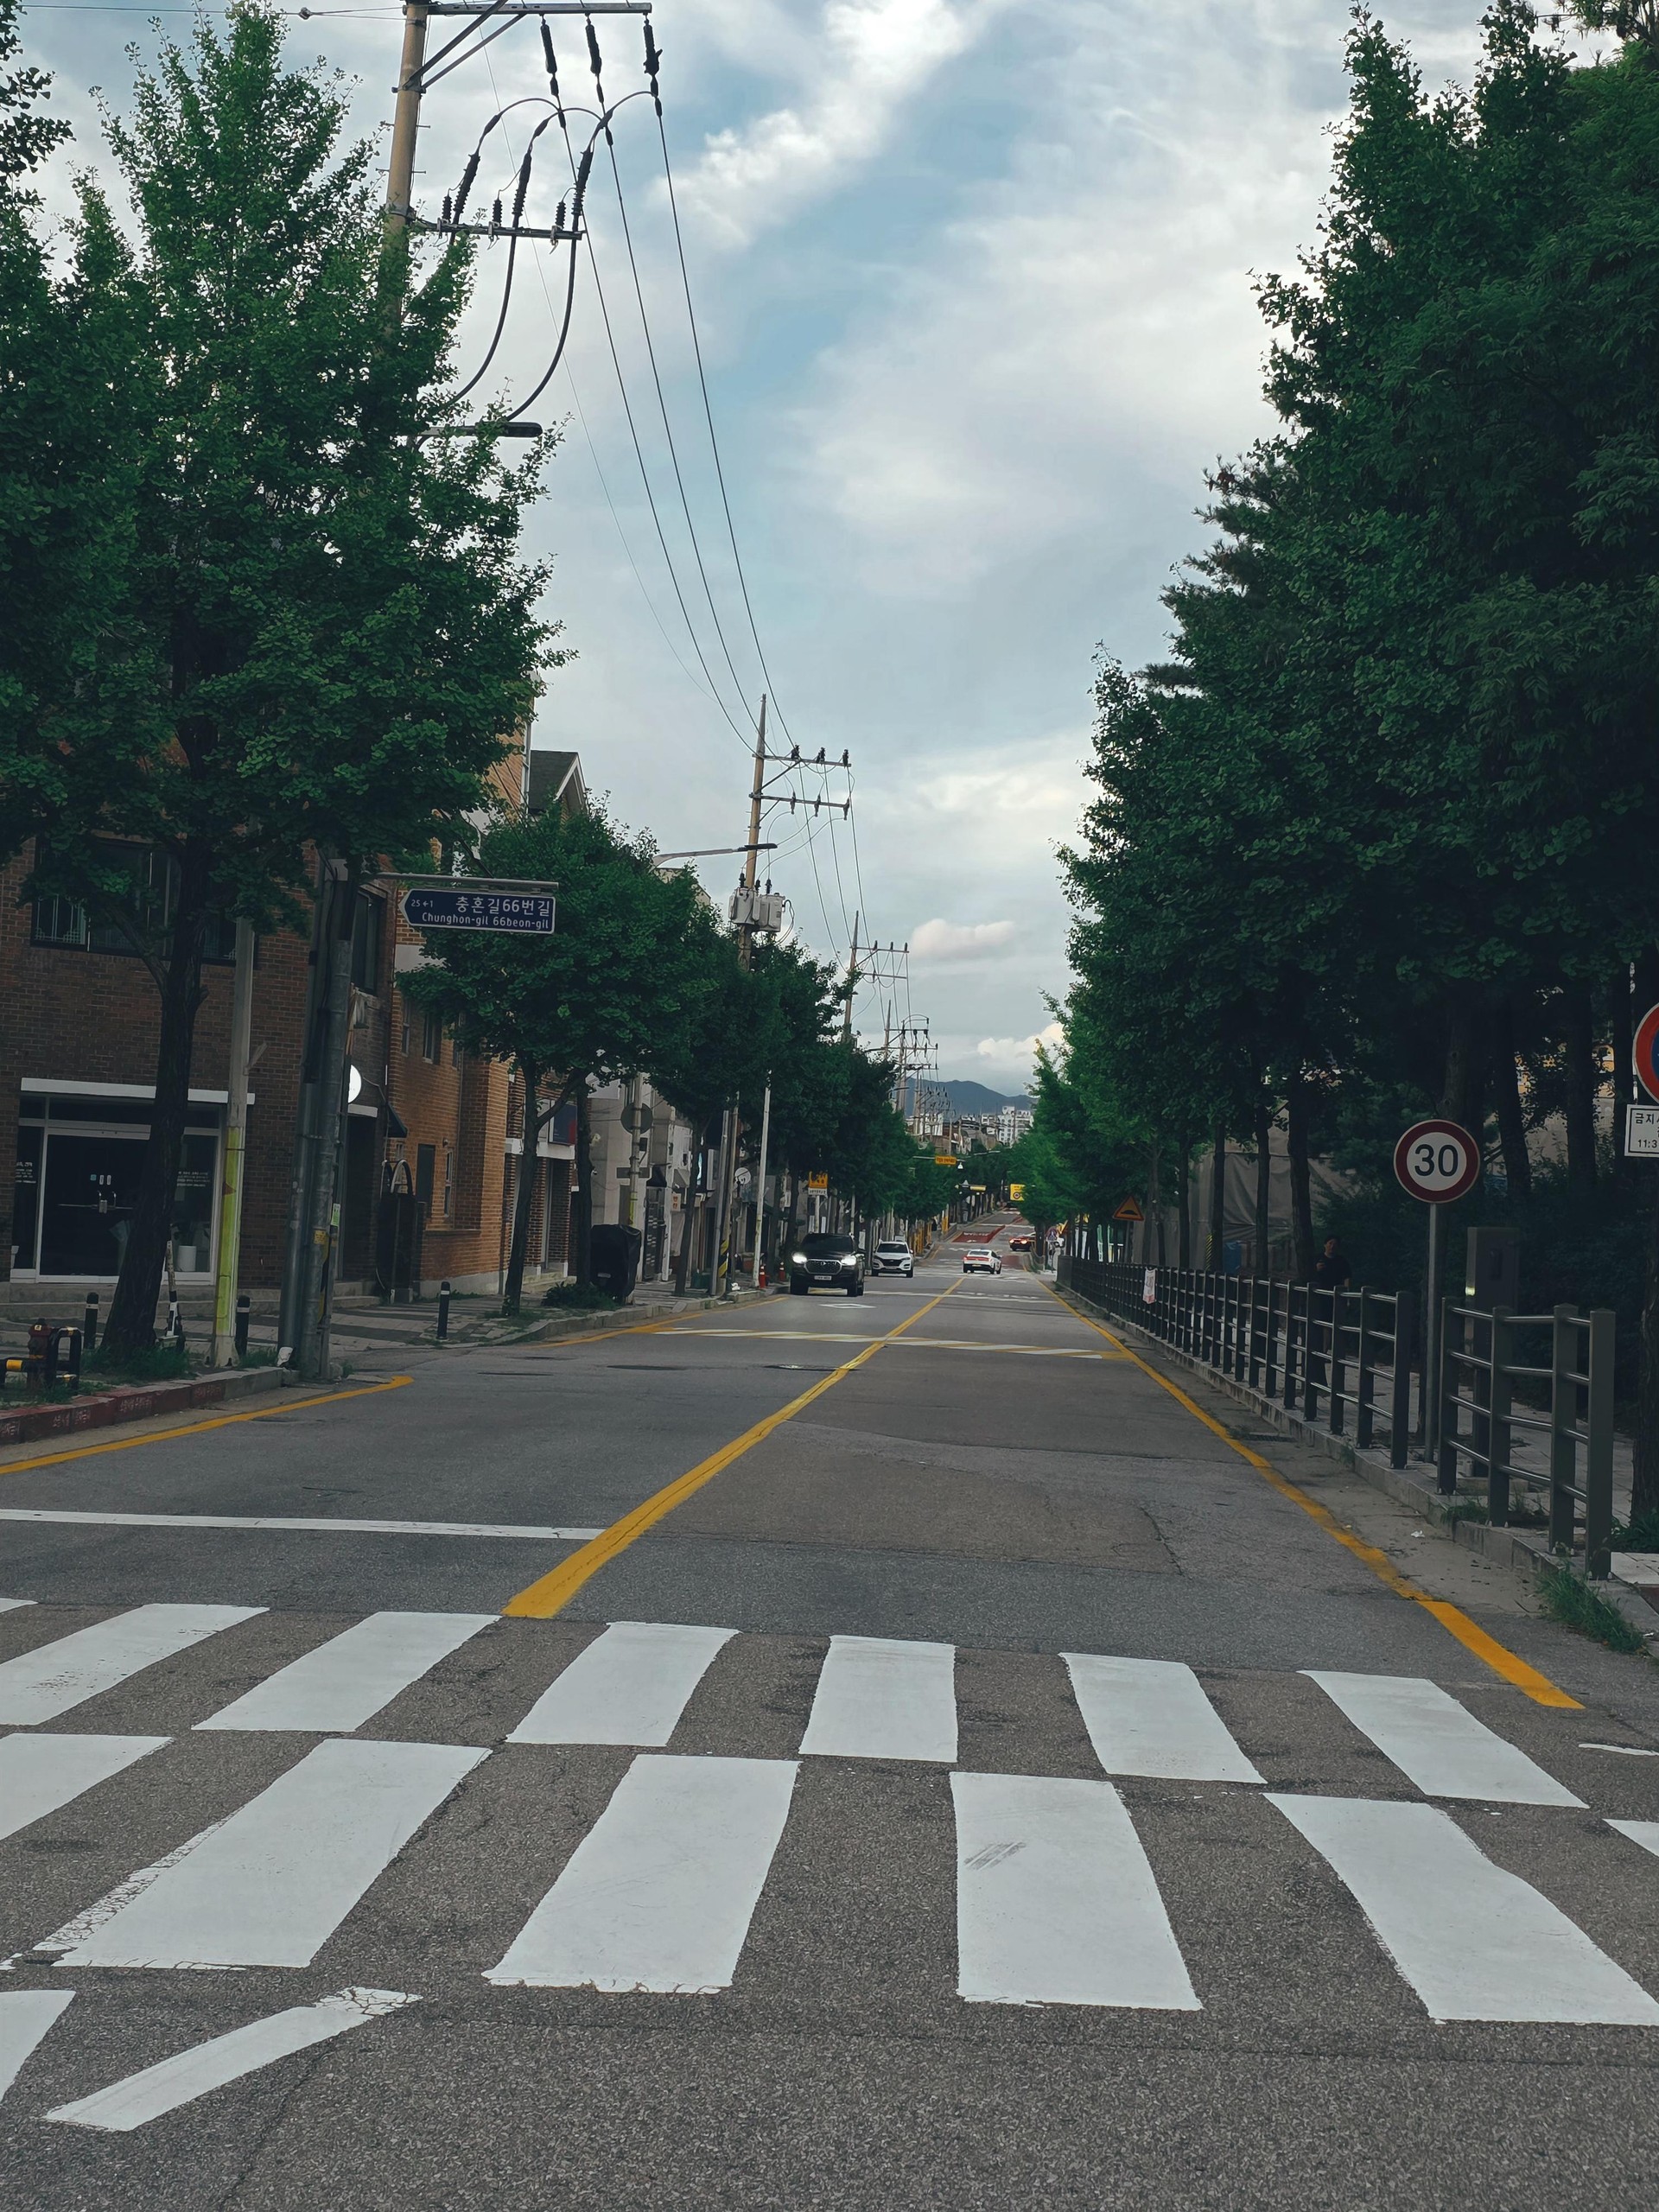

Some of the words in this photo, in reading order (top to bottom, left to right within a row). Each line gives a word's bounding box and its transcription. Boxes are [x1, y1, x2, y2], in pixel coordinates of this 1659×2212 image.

[455, 896, 550, 917] 충혼길66번길
[422, 912, 488, 927] Chunghon-gil
[493, 917, 549, 931] 66beon-gil
[1414, 1144, 1459, 1177] 30
